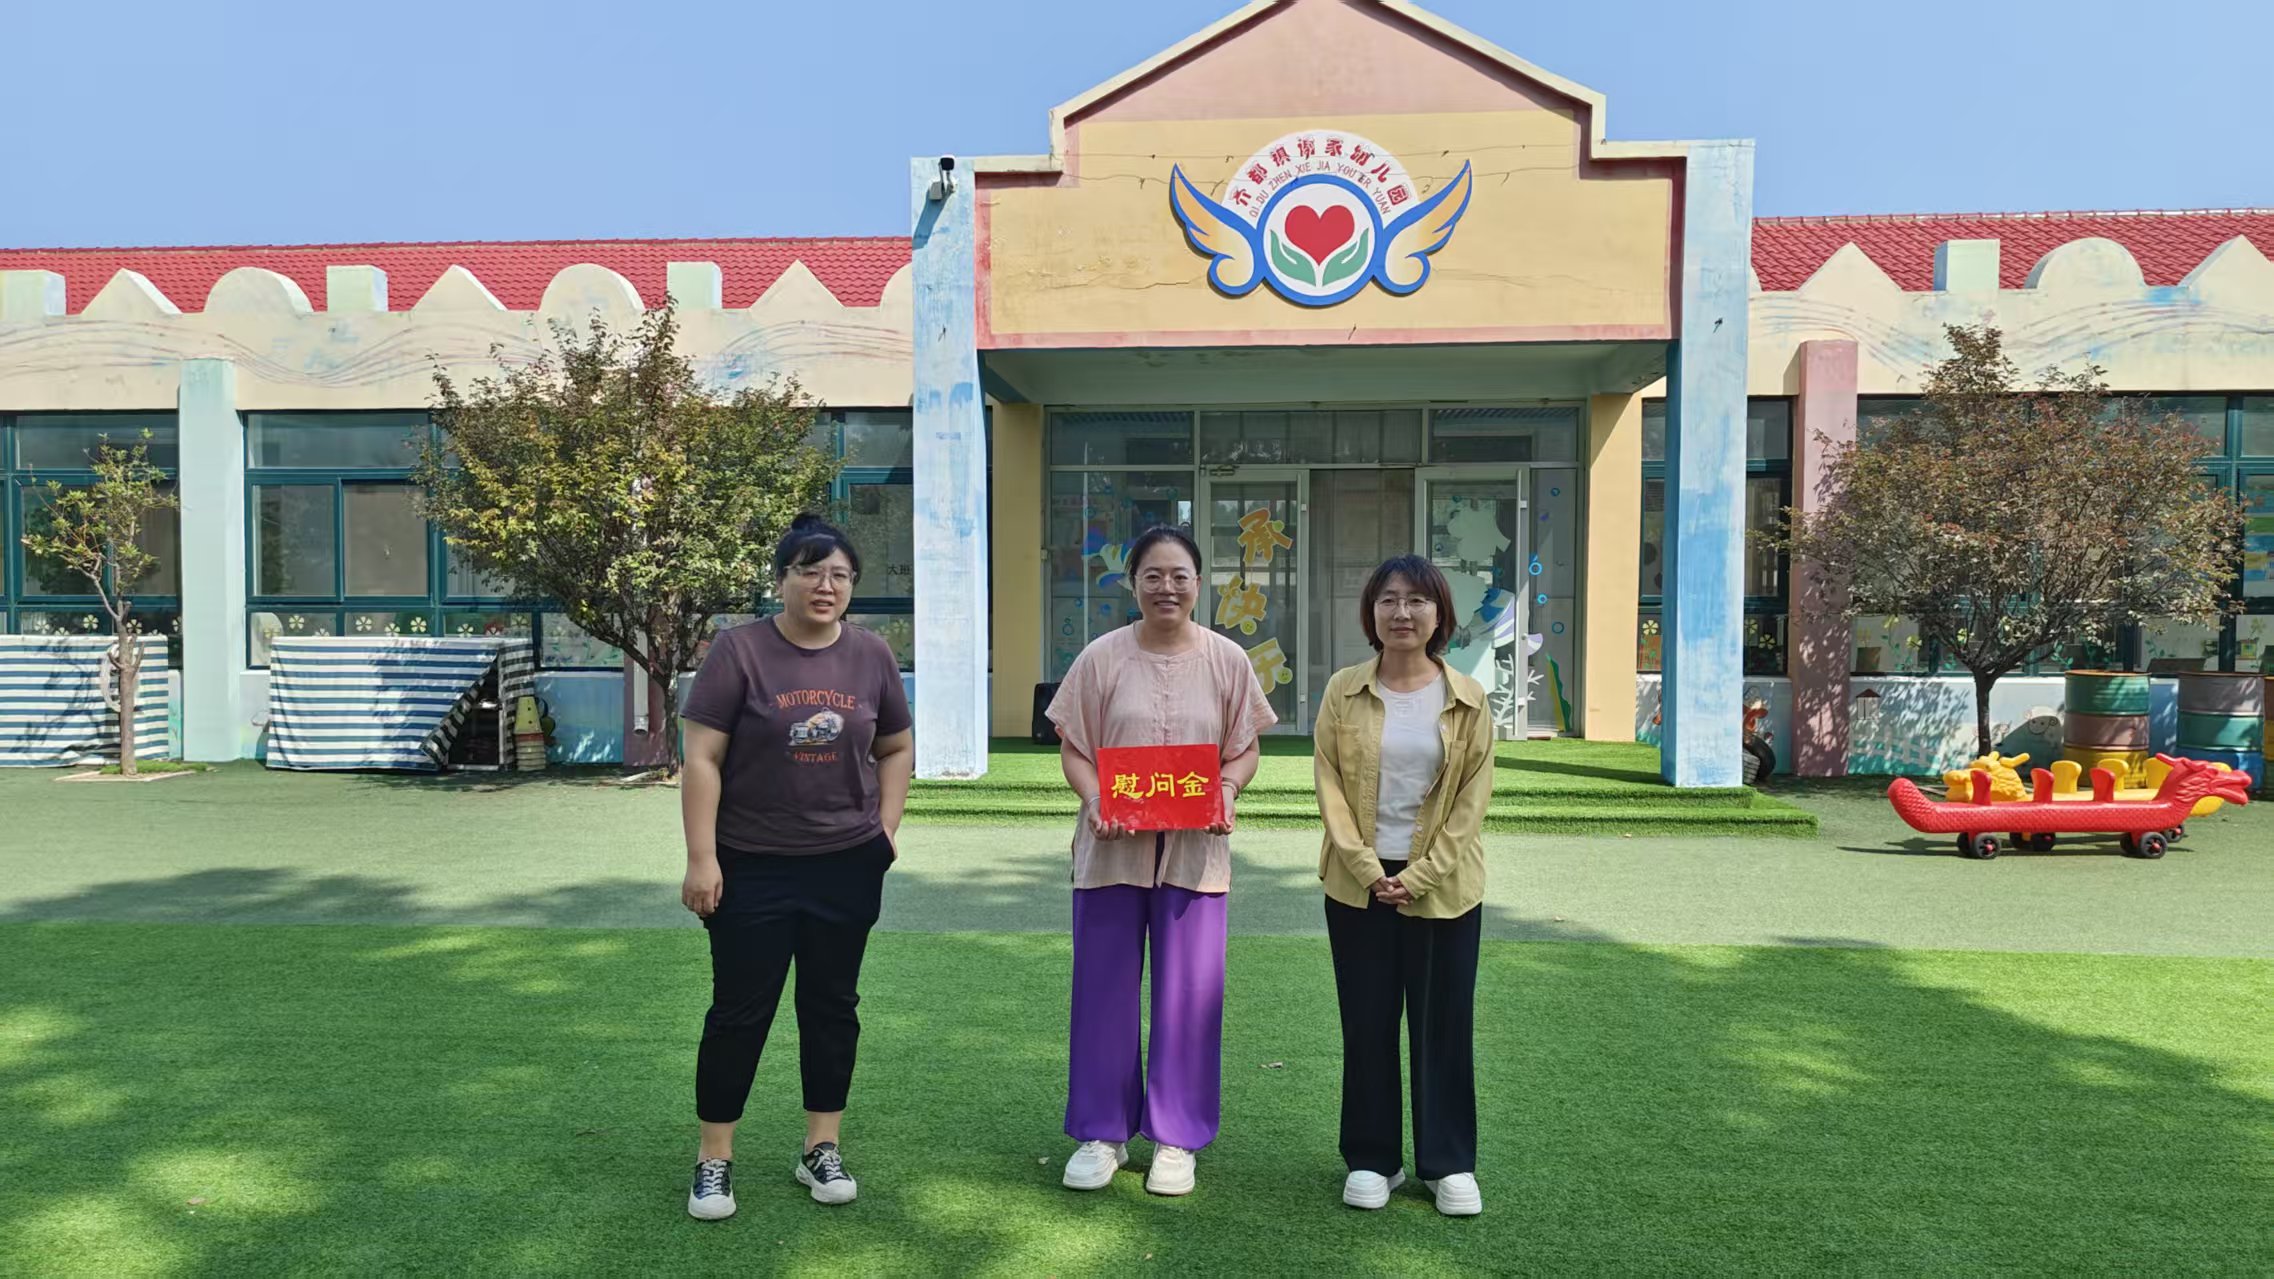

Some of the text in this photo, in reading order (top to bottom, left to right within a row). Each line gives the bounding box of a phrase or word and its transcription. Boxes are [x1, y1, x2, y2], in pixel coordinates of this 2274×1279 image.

[1249, 204, 1260, 218] QI
[1256, 190, 1270, 205] DU
[1268, 169, 1293, 191] ZHEN
[1295, 162, 1313, 175] XIE
[1316, 160, 1331, 172] JIA
[1372, 187, 1392, 215] YUAN
[775, 689, 856, 710] MOTORCYCLE
[794, 751, 838, 763] VINTAGE
[1111, 771, 1209, 799] 慰问金
